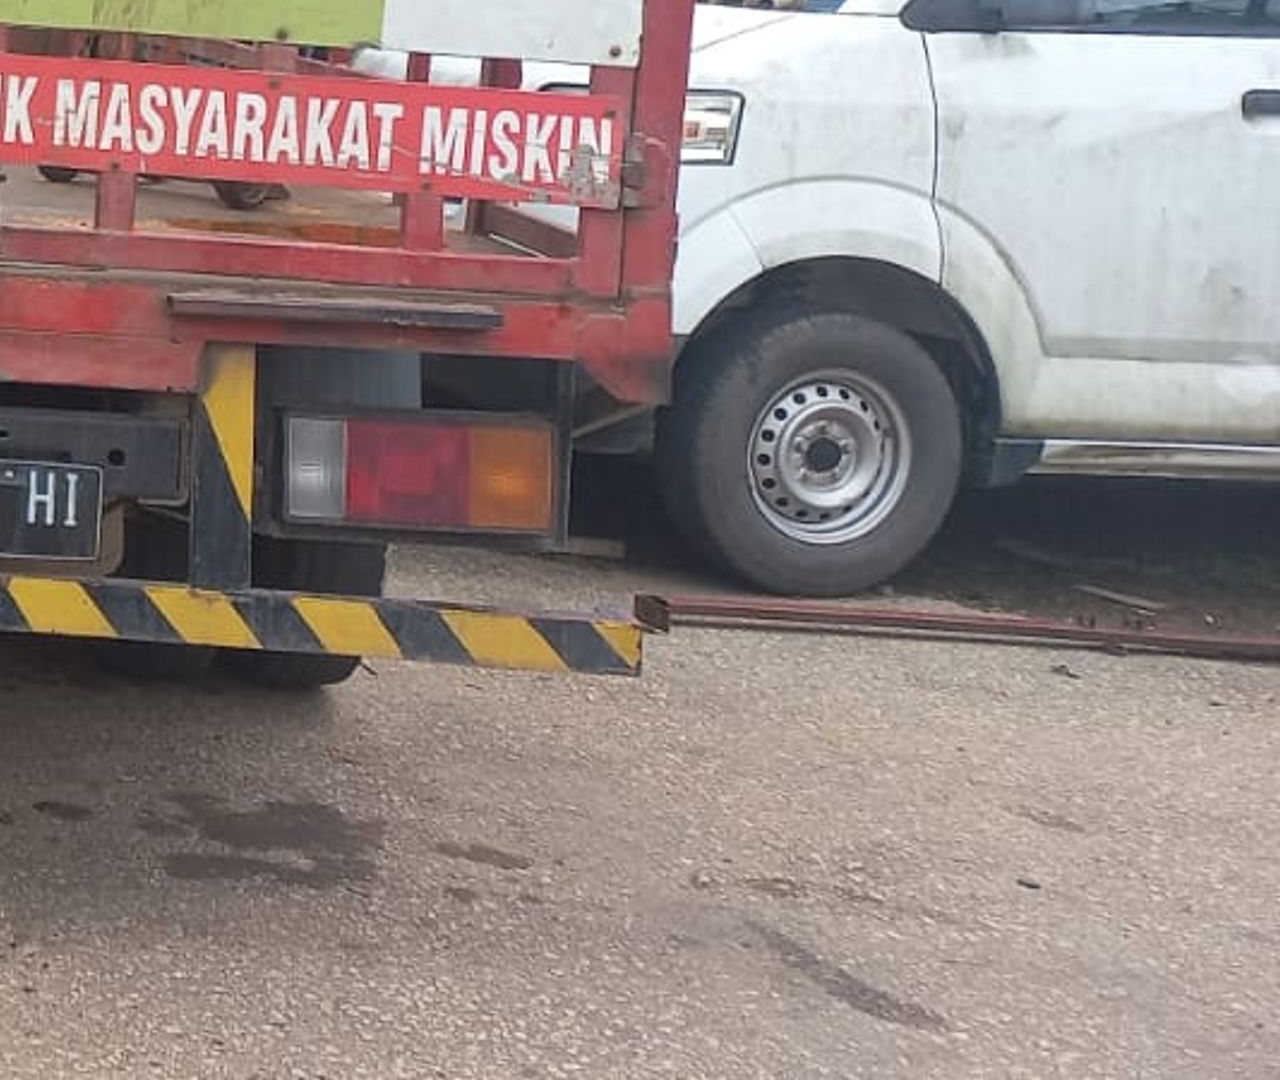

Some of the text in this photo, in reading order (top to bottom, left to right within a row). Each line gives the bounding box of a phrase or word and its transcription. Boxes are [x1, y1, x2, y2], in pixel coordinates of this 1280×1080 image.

[53, 79, 403, 172] MASYARAKAT
[419, 106, 612, 184] MISKIN
[27, 470, 78, 527] HI
